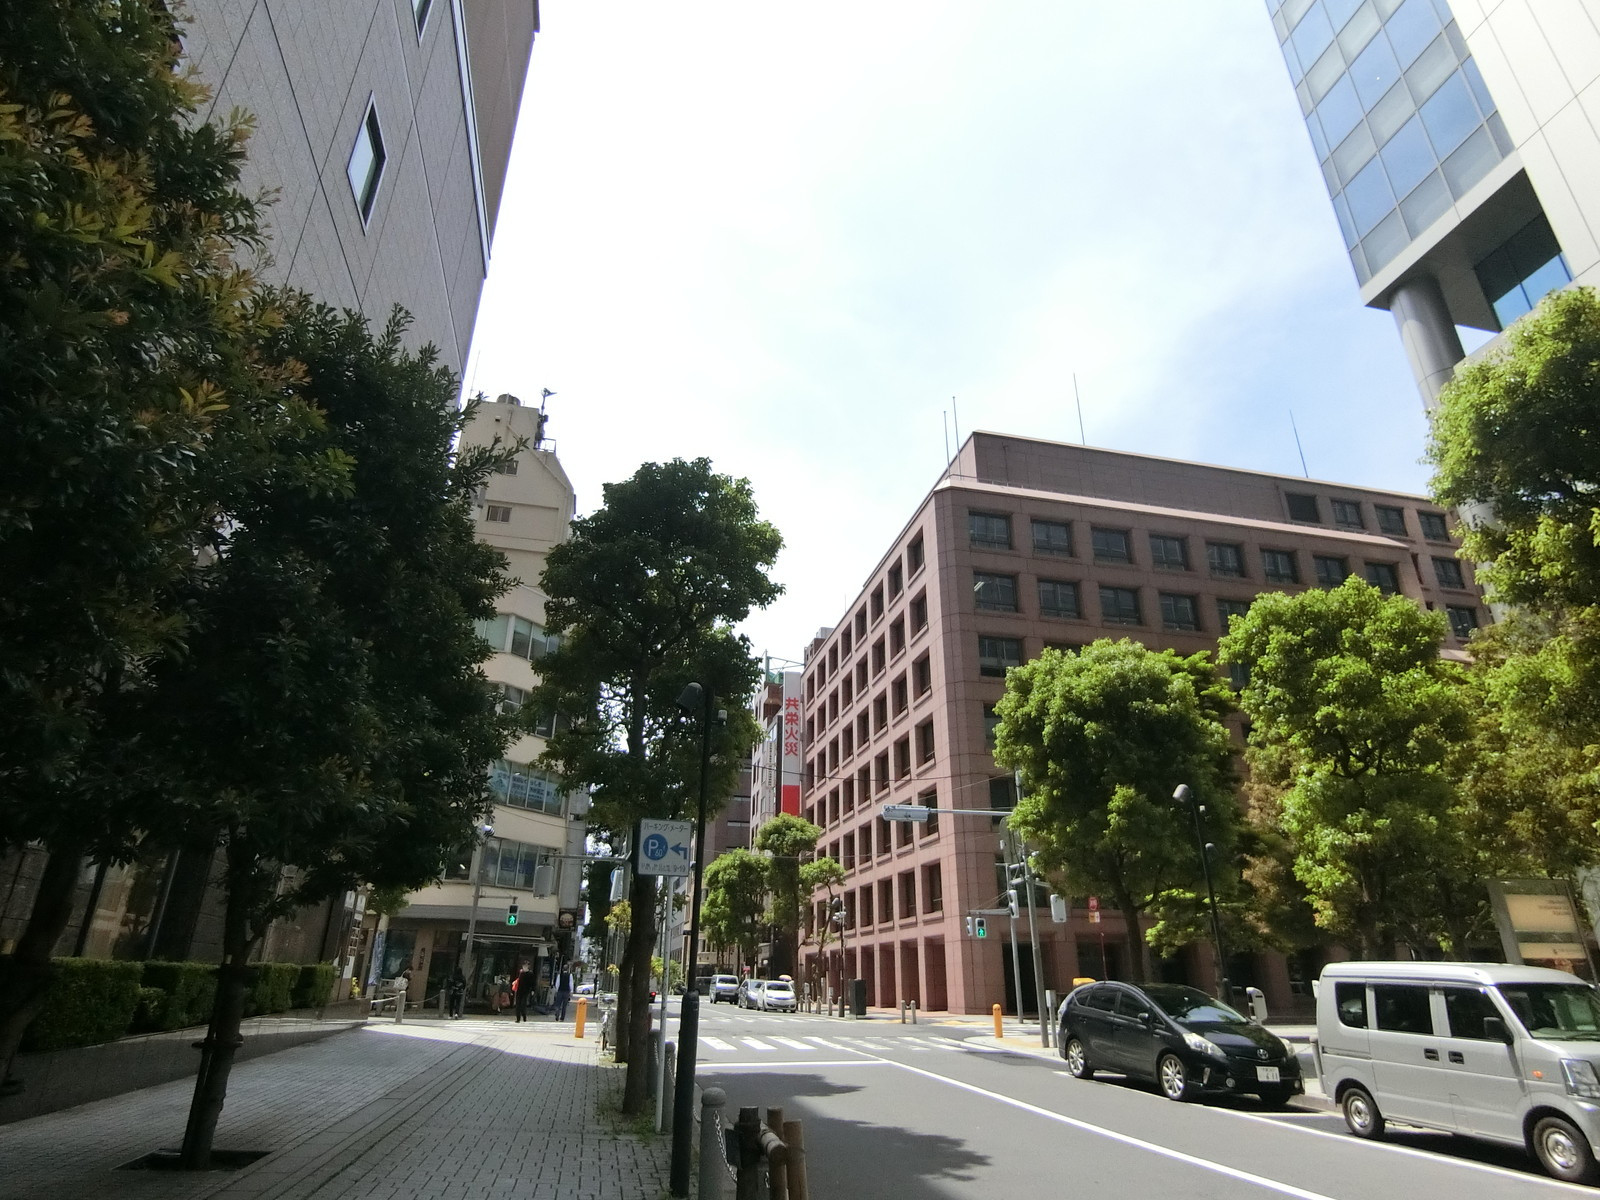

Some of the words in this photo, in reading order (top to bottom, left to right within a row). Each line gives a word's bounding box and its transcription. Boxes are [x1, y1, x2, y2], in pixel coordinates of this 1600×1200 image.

[785, 697, 799, 757] 共栄火災
[648, 839, 658, 857] P
